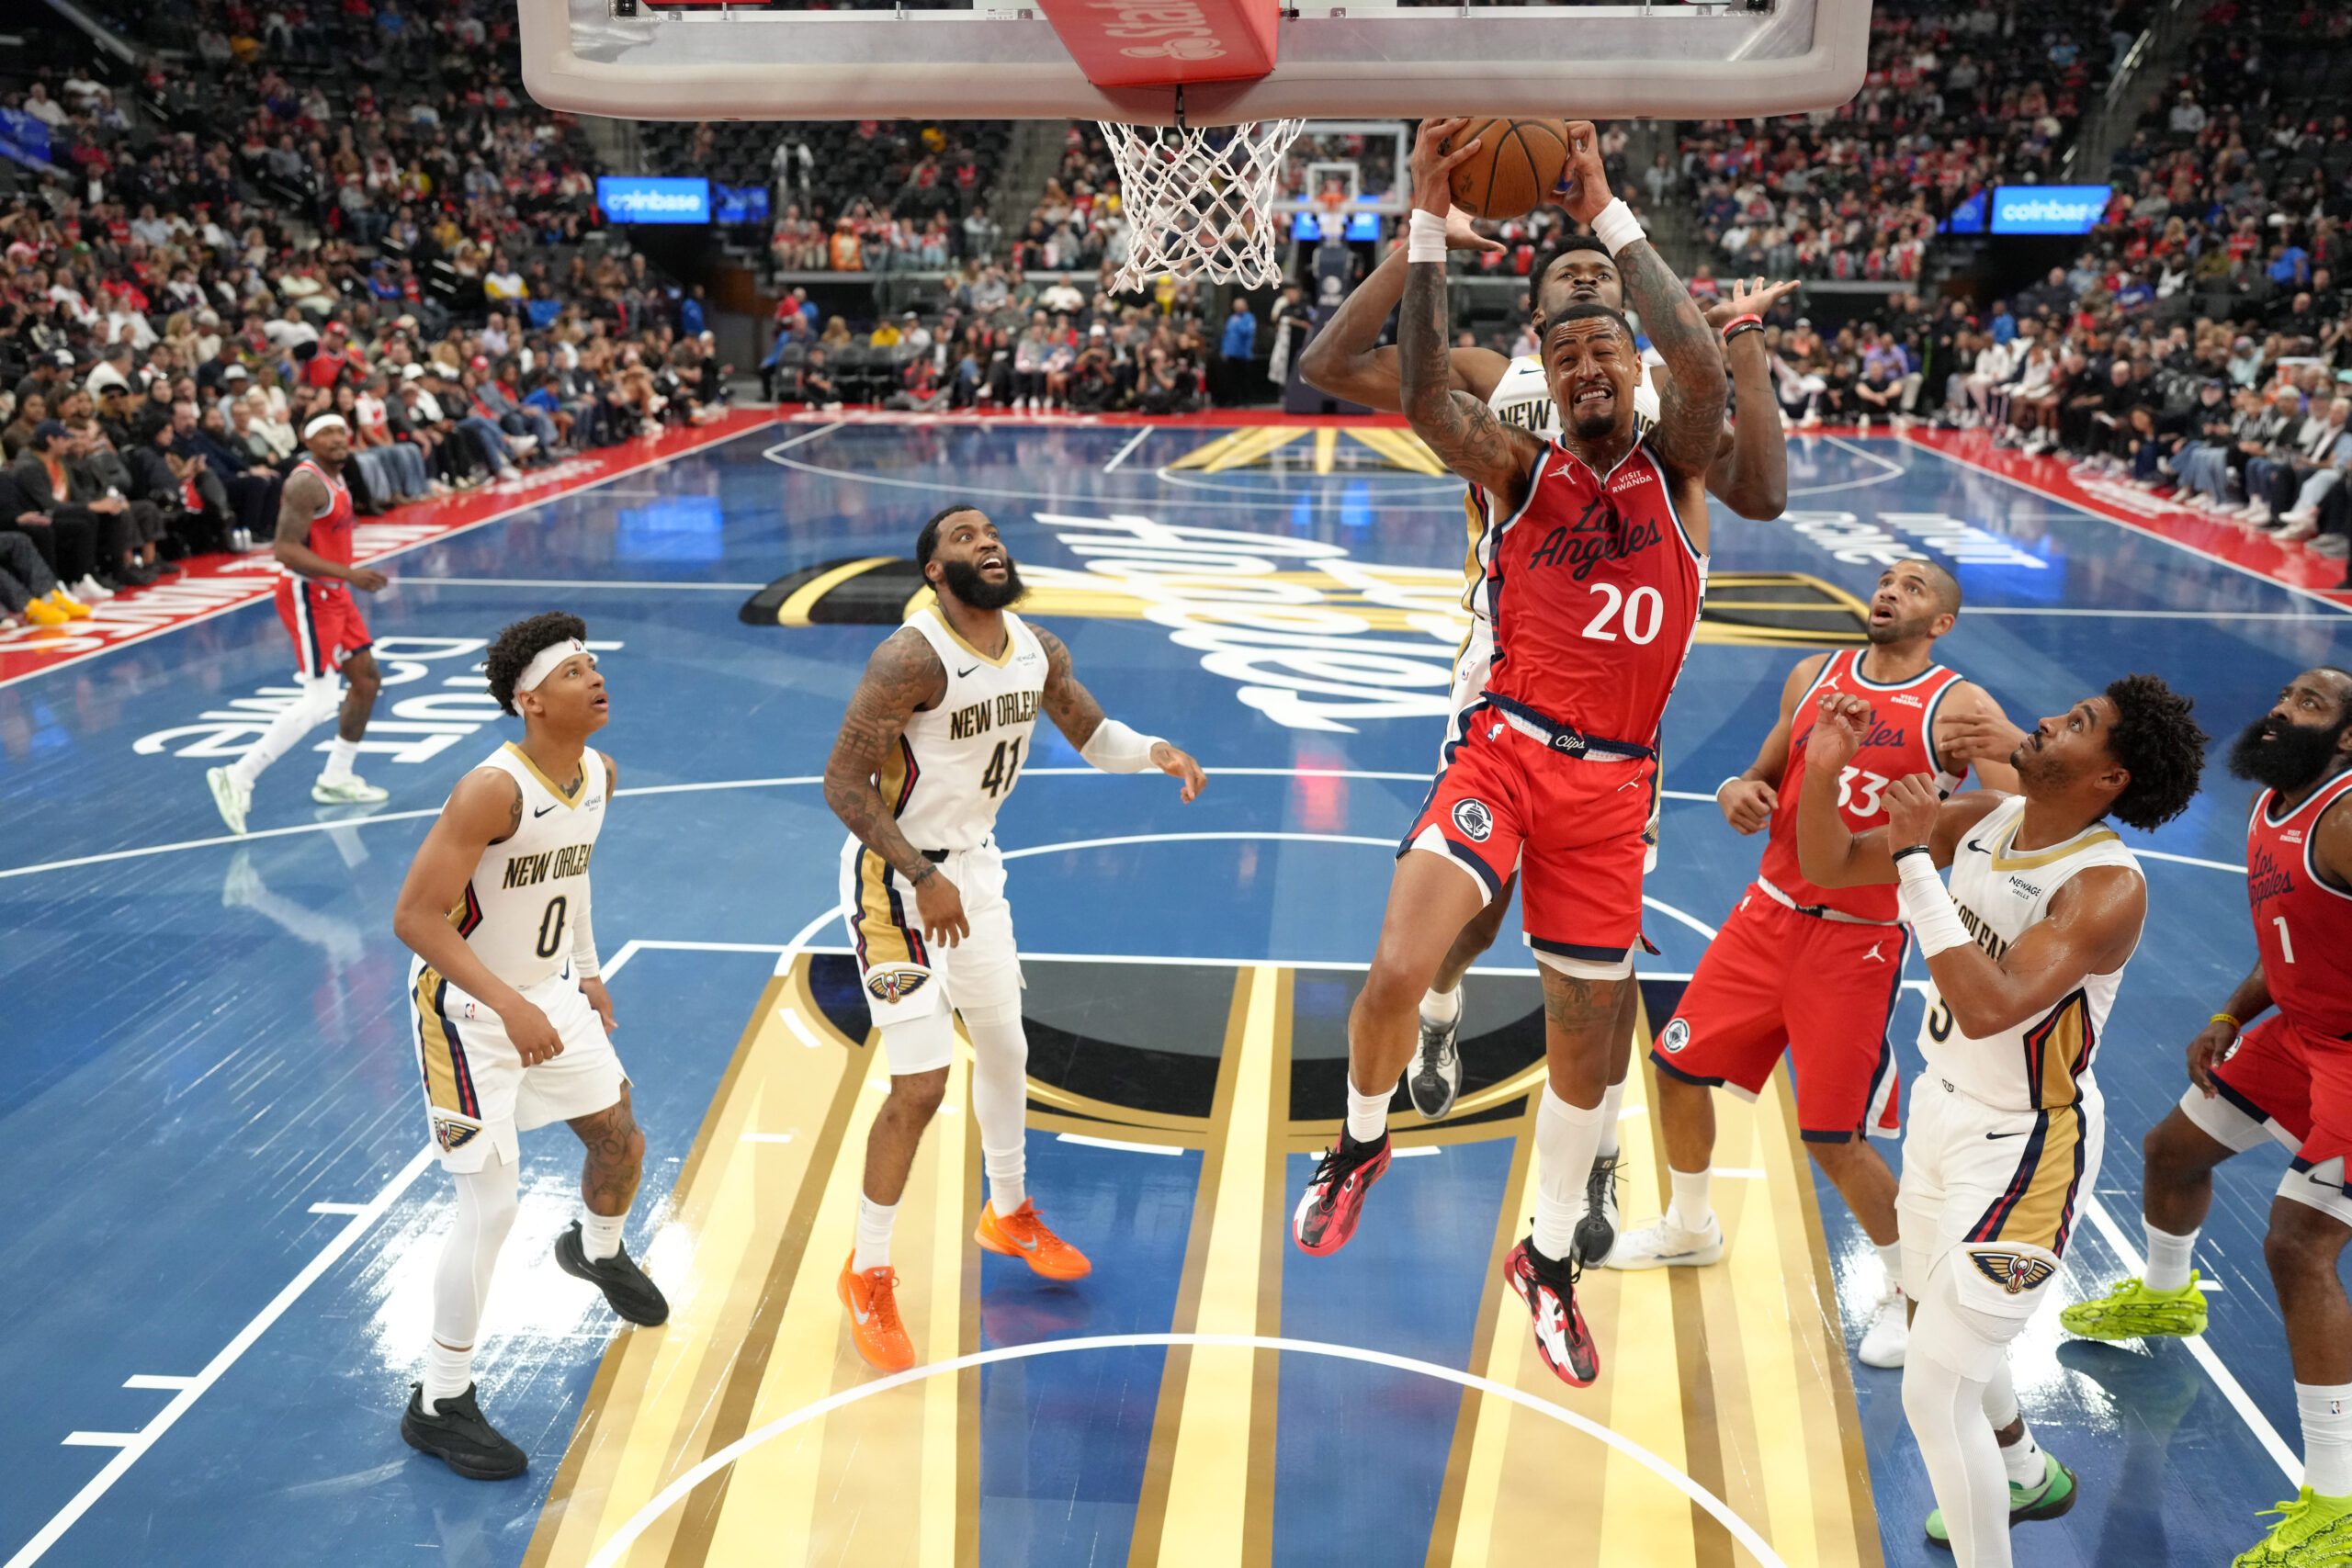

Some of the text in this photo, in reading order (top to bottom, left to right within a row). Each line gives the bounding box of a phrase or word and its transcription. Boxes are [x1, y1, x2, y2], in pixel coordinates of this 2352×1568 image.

[1087, 0, 1213, 38] Stat
[606, 189, 701, 211] coinbase
[1498, 399, 1551, 431] NEW
[1611, 474, 1653, 493] RWANDA
[1619, 469, 1641, 483] VISIT
[1527, 516, 1663, 581] Angeles
[1581, 581, 1664, 645] 20
[950, 691, 1041, 740] NEW ORLEA
[1555, 735, 1585, 750] Clips
[980, 735, 1022, 798] 41
[1838, 765, 1890, 818] 33
[502, 851, 553, 889] NEW
[2251, 844, 2274, 880] Los
[2009, 875, 2042, 897] NEWAGE
[2012, 887, 2030, 900] GRILLS
[537, 895, 567, 958] 0
[2272, 916, 2295, 964] 1
